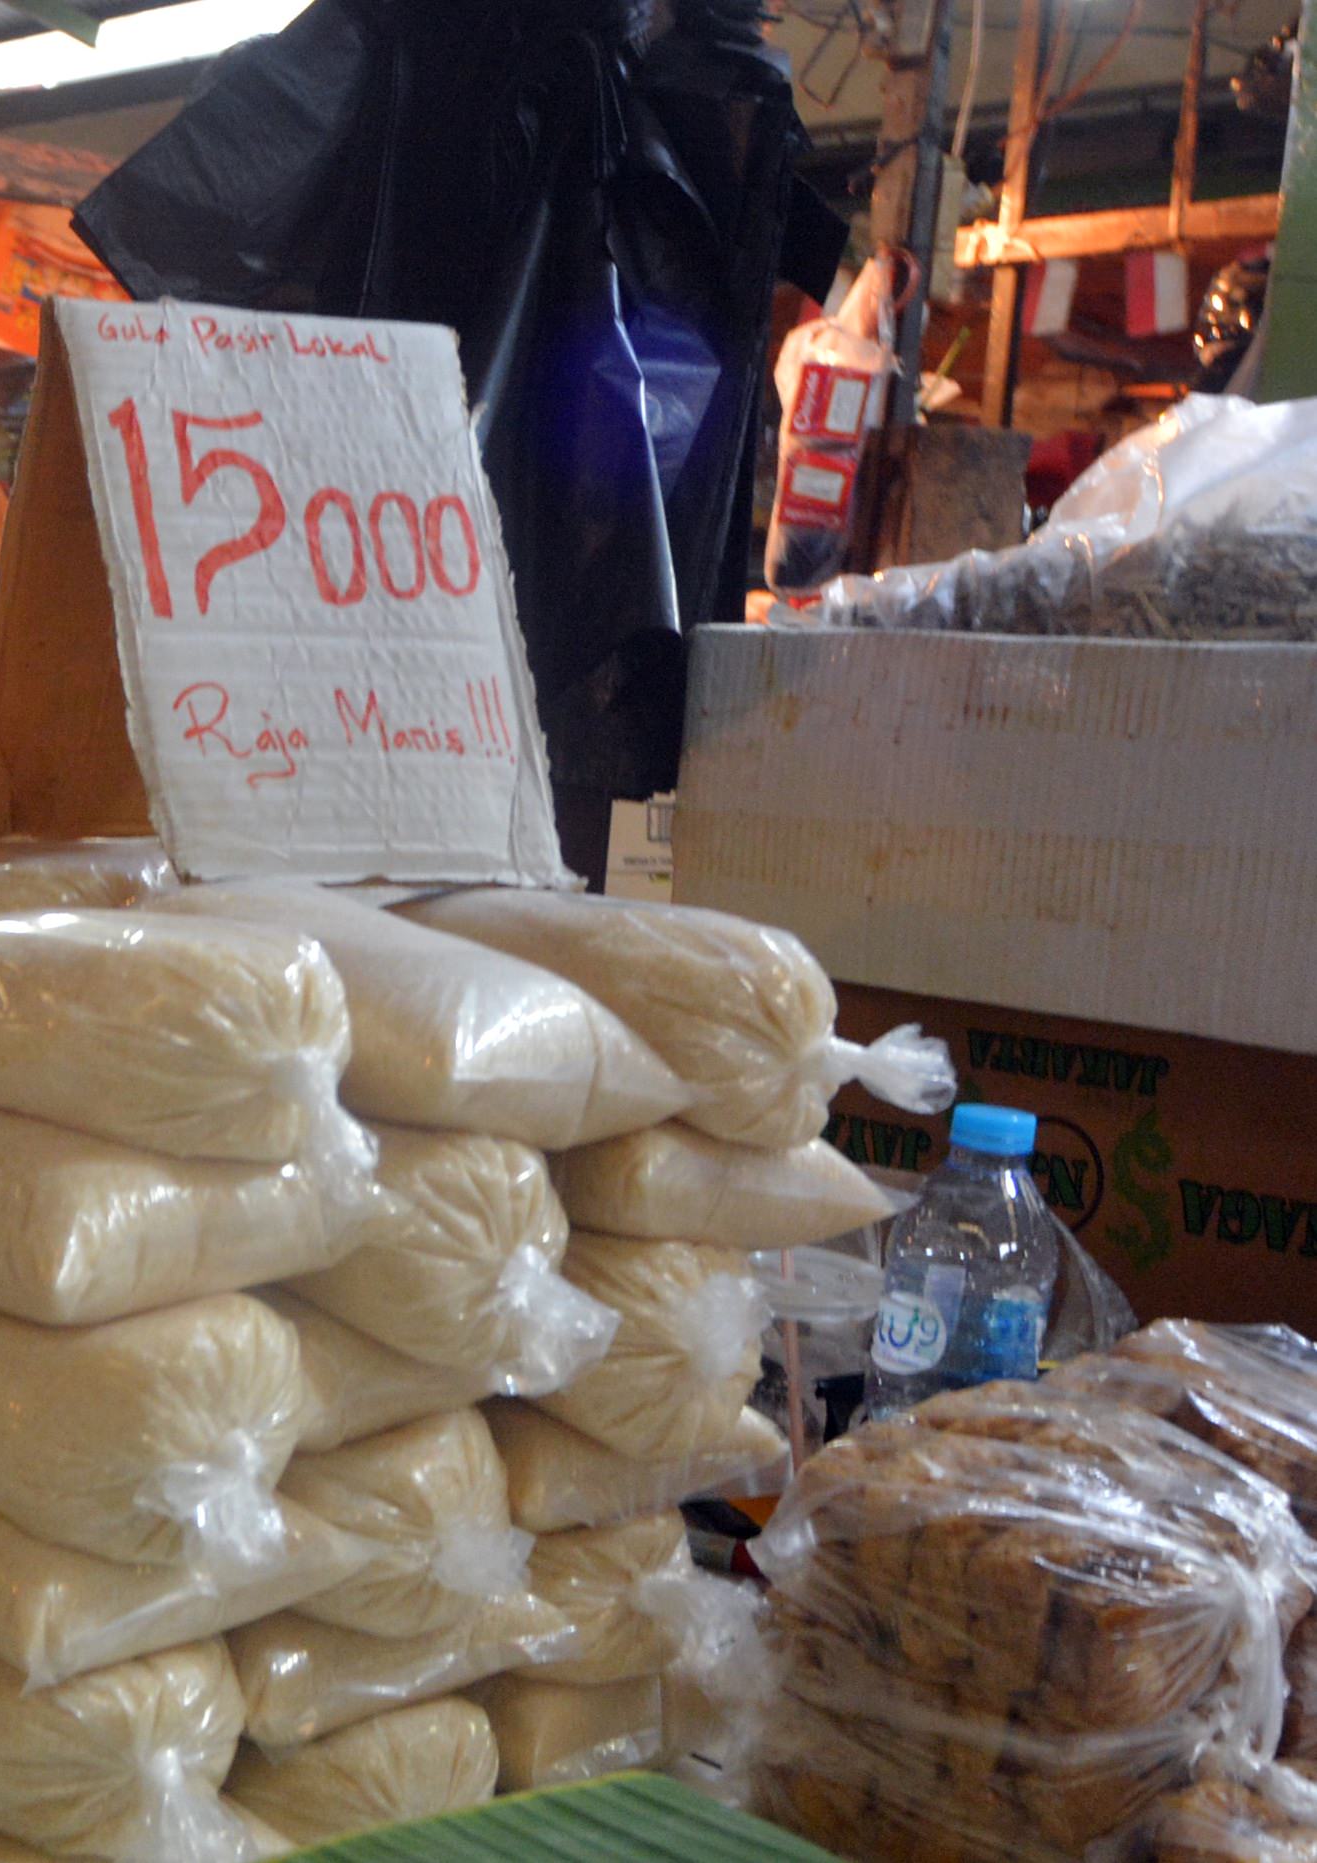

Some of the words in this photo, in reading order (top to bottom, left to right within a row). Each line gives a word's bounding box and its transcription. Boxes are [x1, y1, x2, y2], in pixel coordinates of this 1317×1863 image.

[191, 315, 274, 358] Pasir
[172, 681, 308, 791] Raja
[968, 1028, 1170, 1097] JAKARTA
